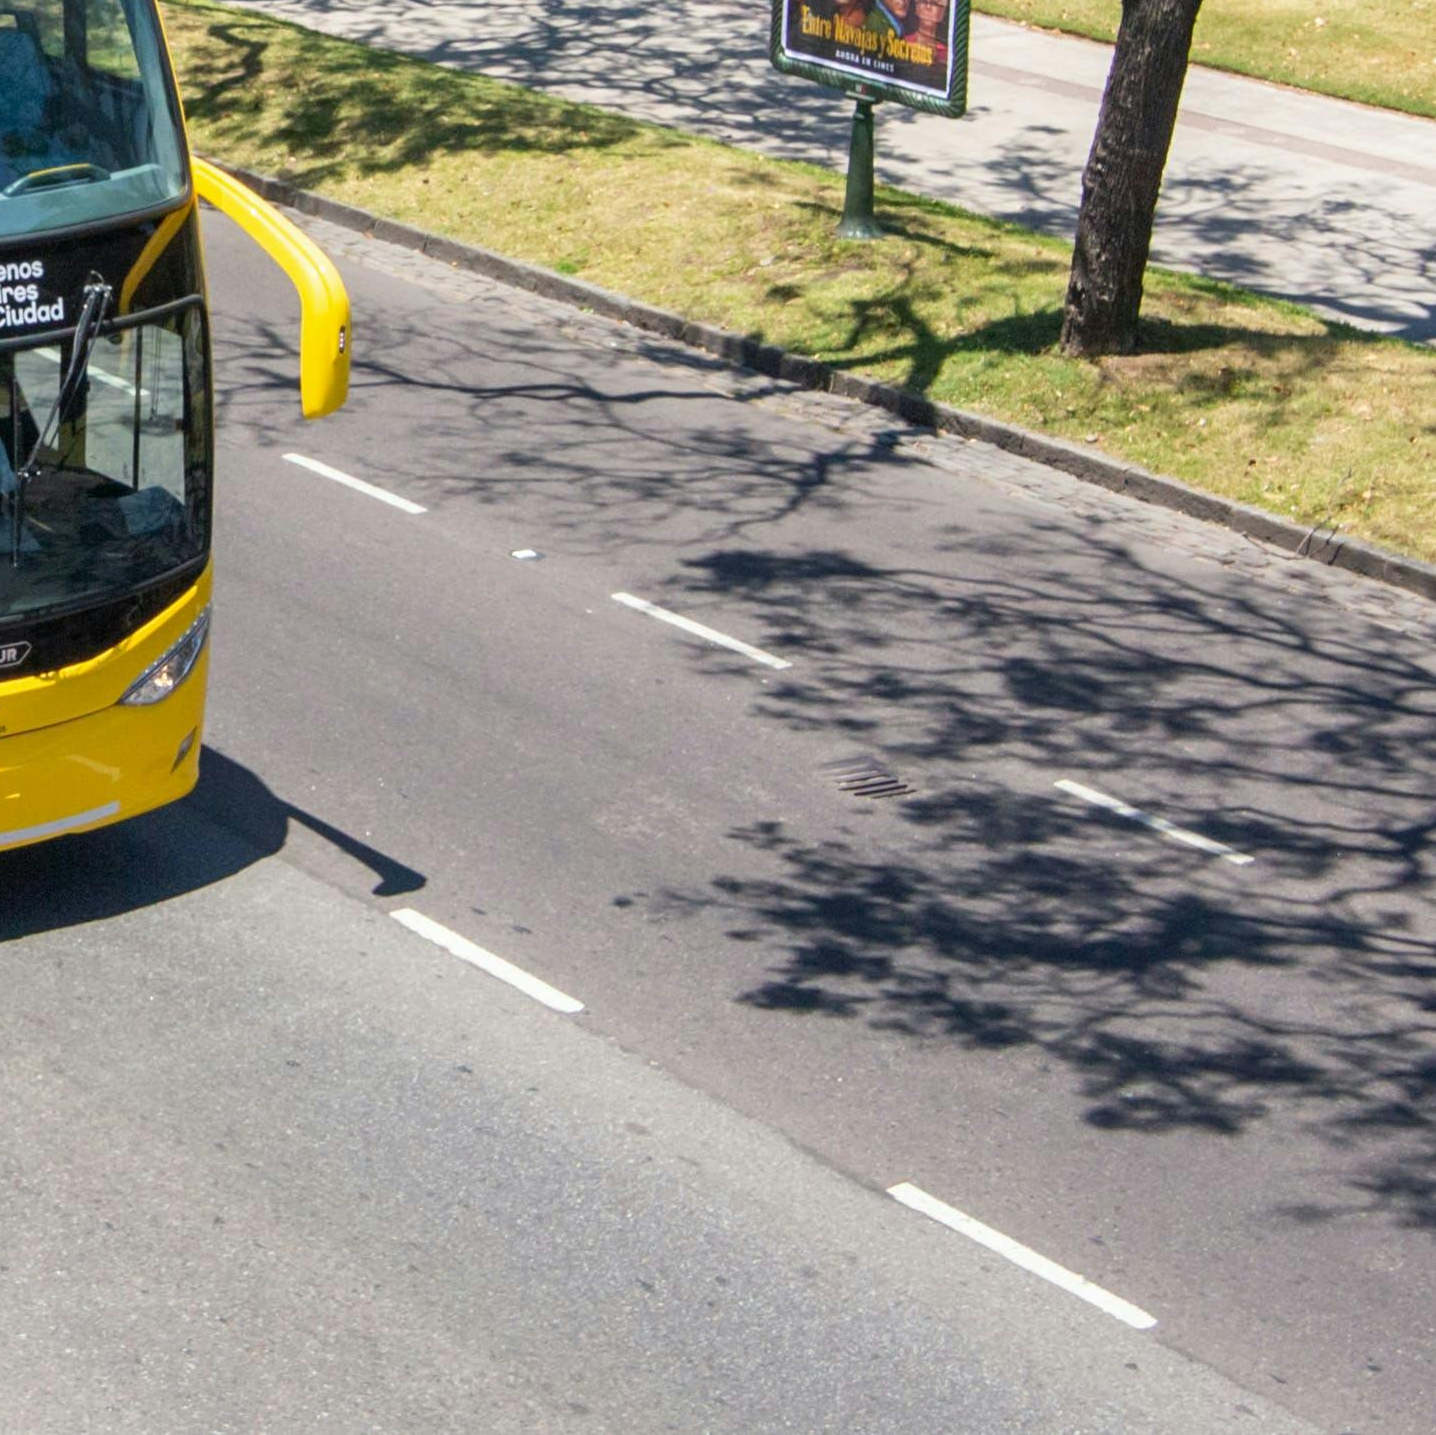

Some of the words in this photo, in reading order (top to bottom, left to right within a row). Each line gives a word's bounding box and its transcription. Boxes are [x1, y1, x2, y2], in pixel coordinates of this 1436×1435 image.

[801, 4, 832, 39] Entre
[833, 13, 878, 56] Navajas
[878, 34, 888, 59] y
